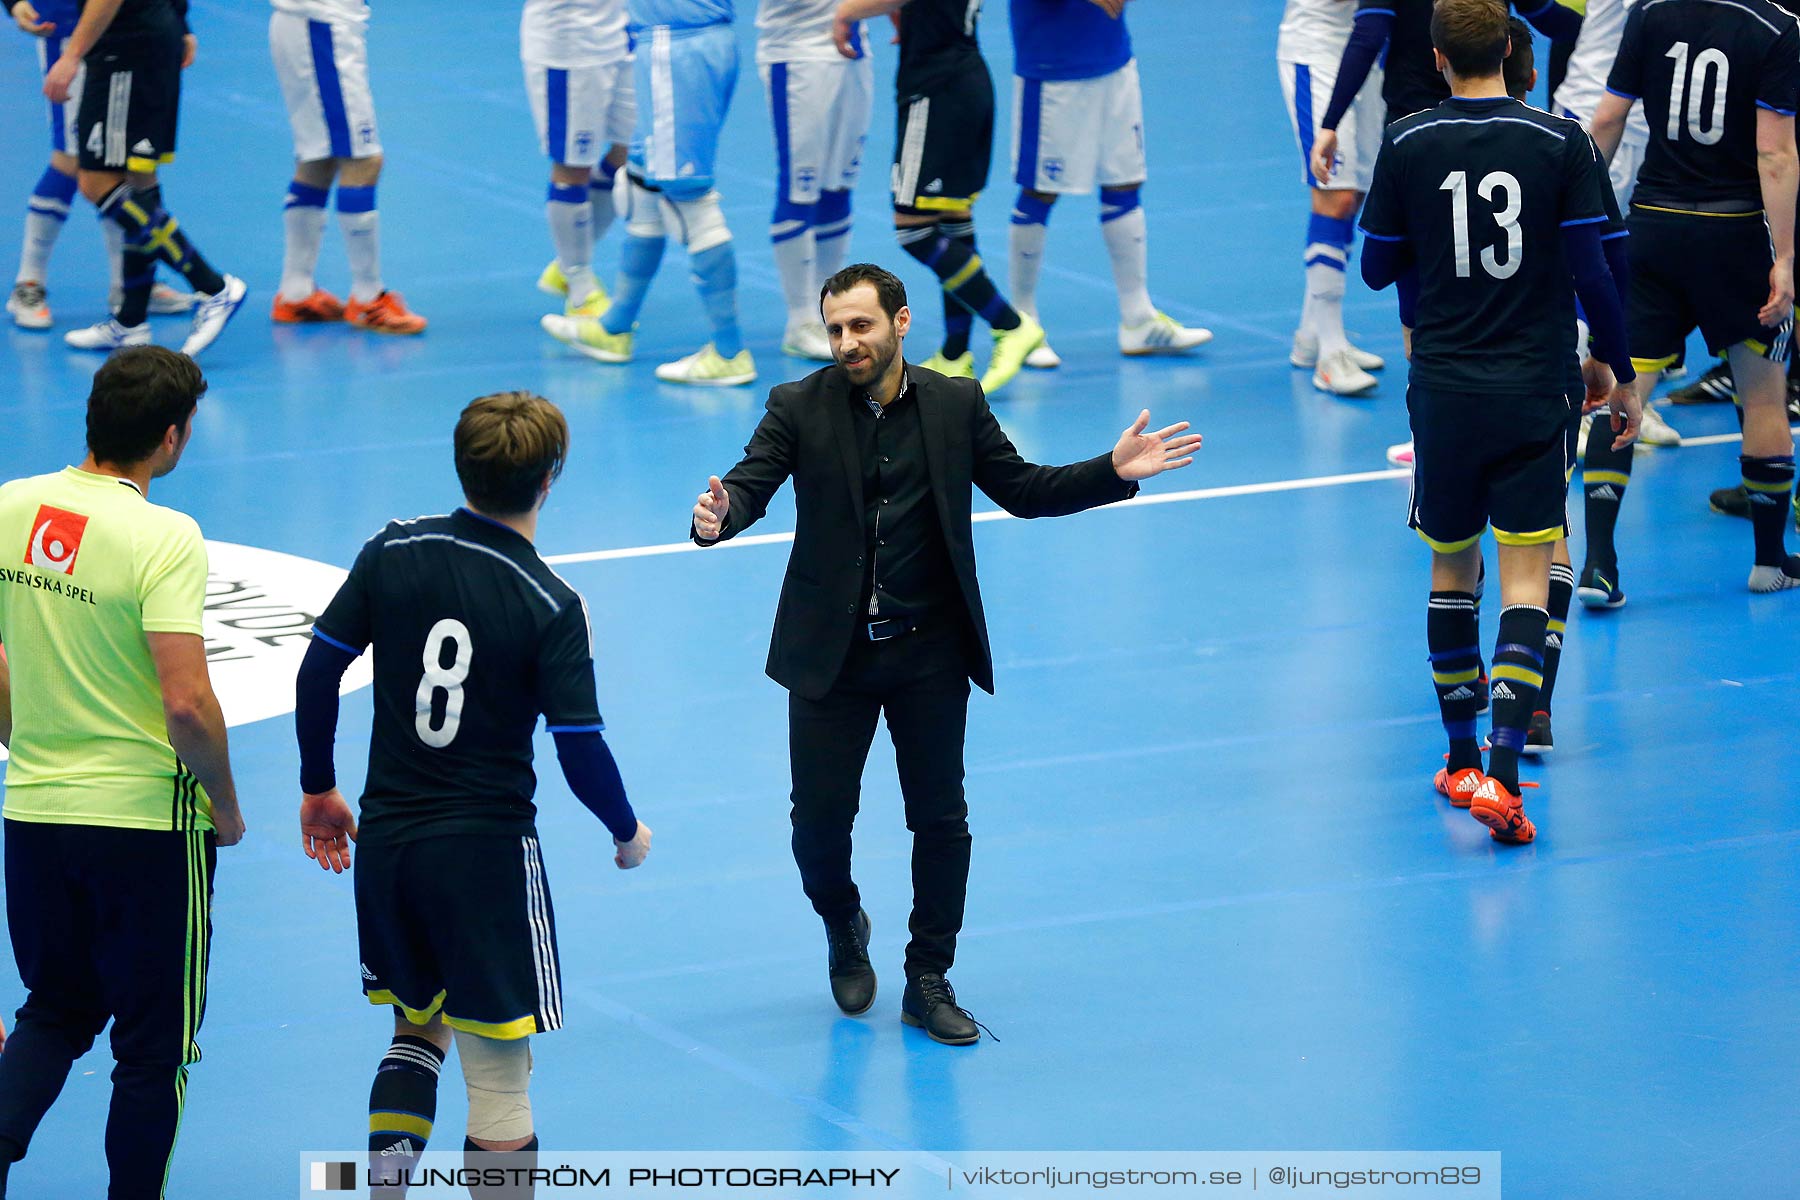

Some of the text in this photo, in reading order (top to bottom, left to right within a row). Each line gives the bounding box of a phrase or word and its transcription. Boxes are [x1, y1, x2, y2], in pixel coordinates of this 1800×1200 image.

[86, 121, 104, 160] 4
[1665, 41, 1729, 145] 10
[1439, 170, 1522, 280] 13
[0, 568, 96, 605] SVENSKA SPEL
[415, 618, 473, 748] 8
